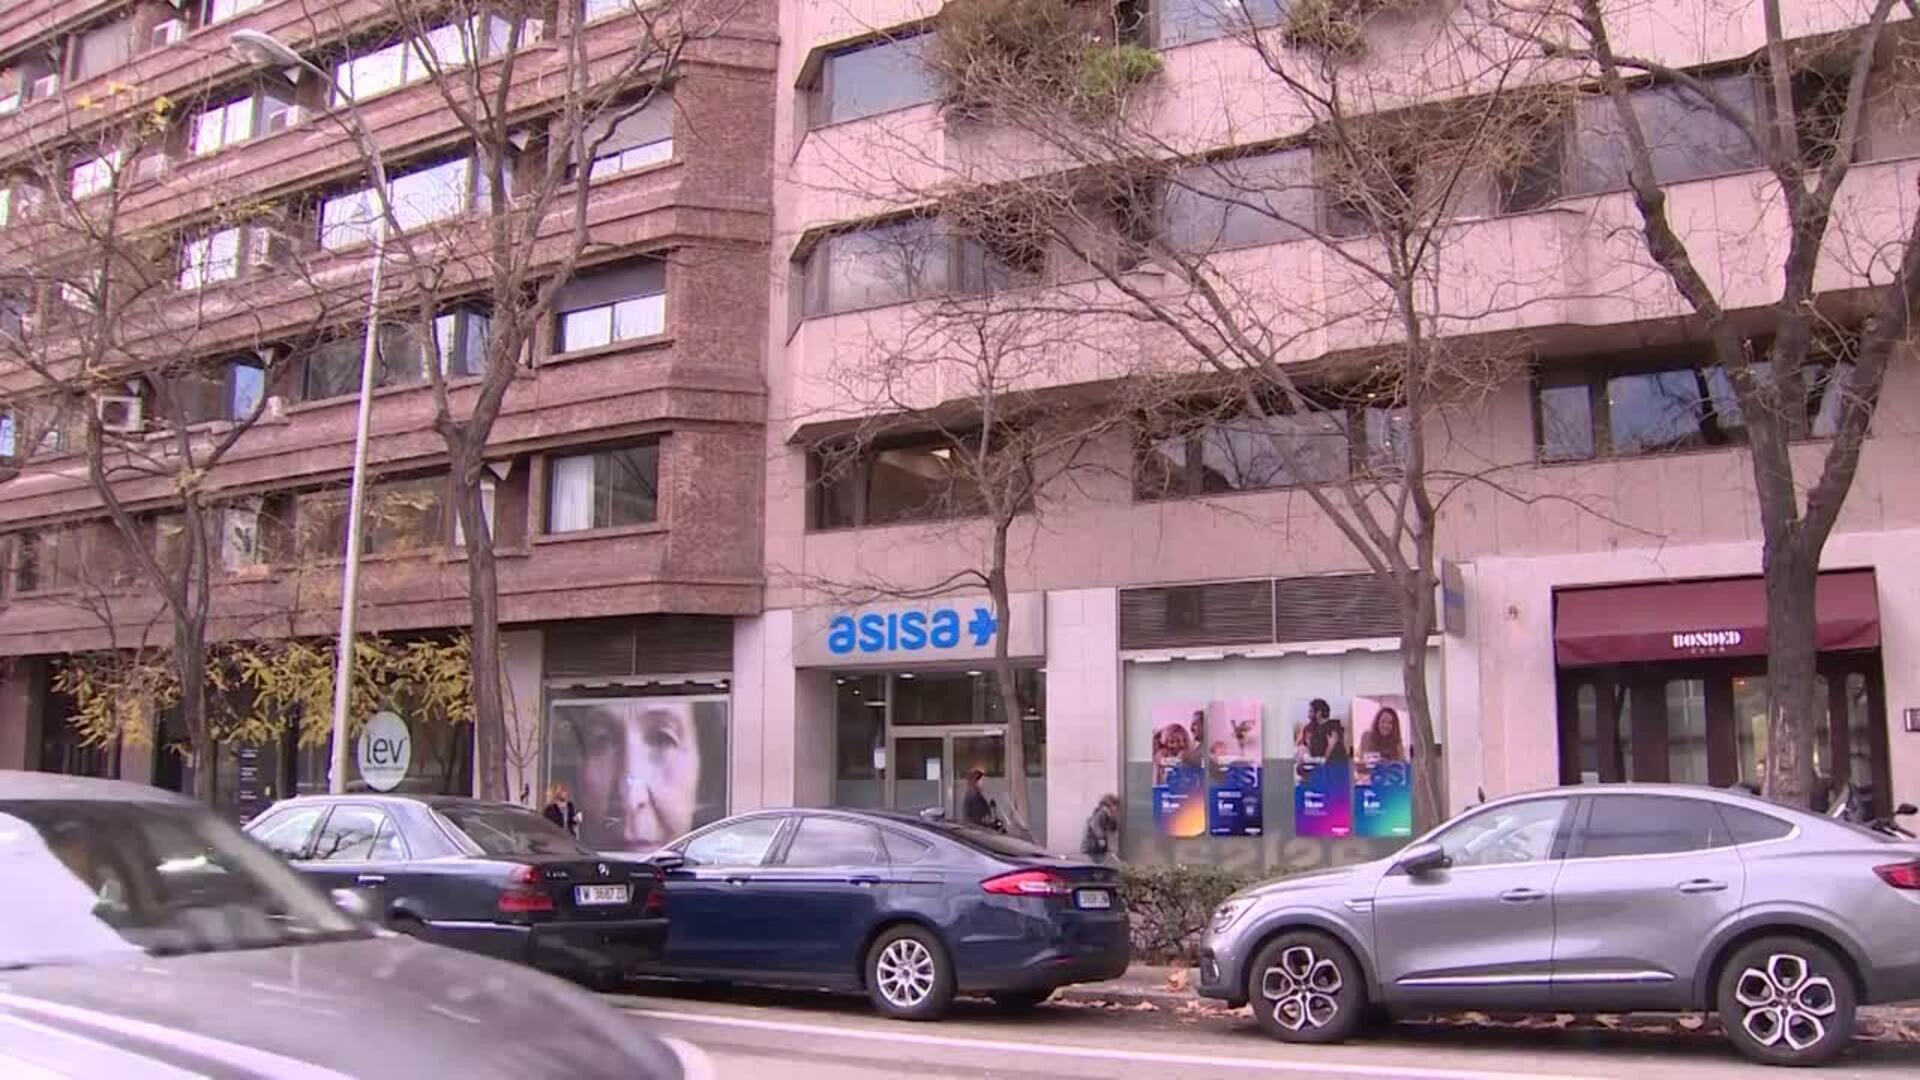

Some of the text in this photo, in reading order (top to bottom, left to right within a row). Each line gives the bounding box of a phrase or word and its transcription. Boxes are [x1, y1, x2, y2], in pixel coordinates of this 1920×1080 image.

[828, 609, 959, 654] asisa
[1673, 631, 1741, 648] BONDED
[366, 734, 404, 764] lev
